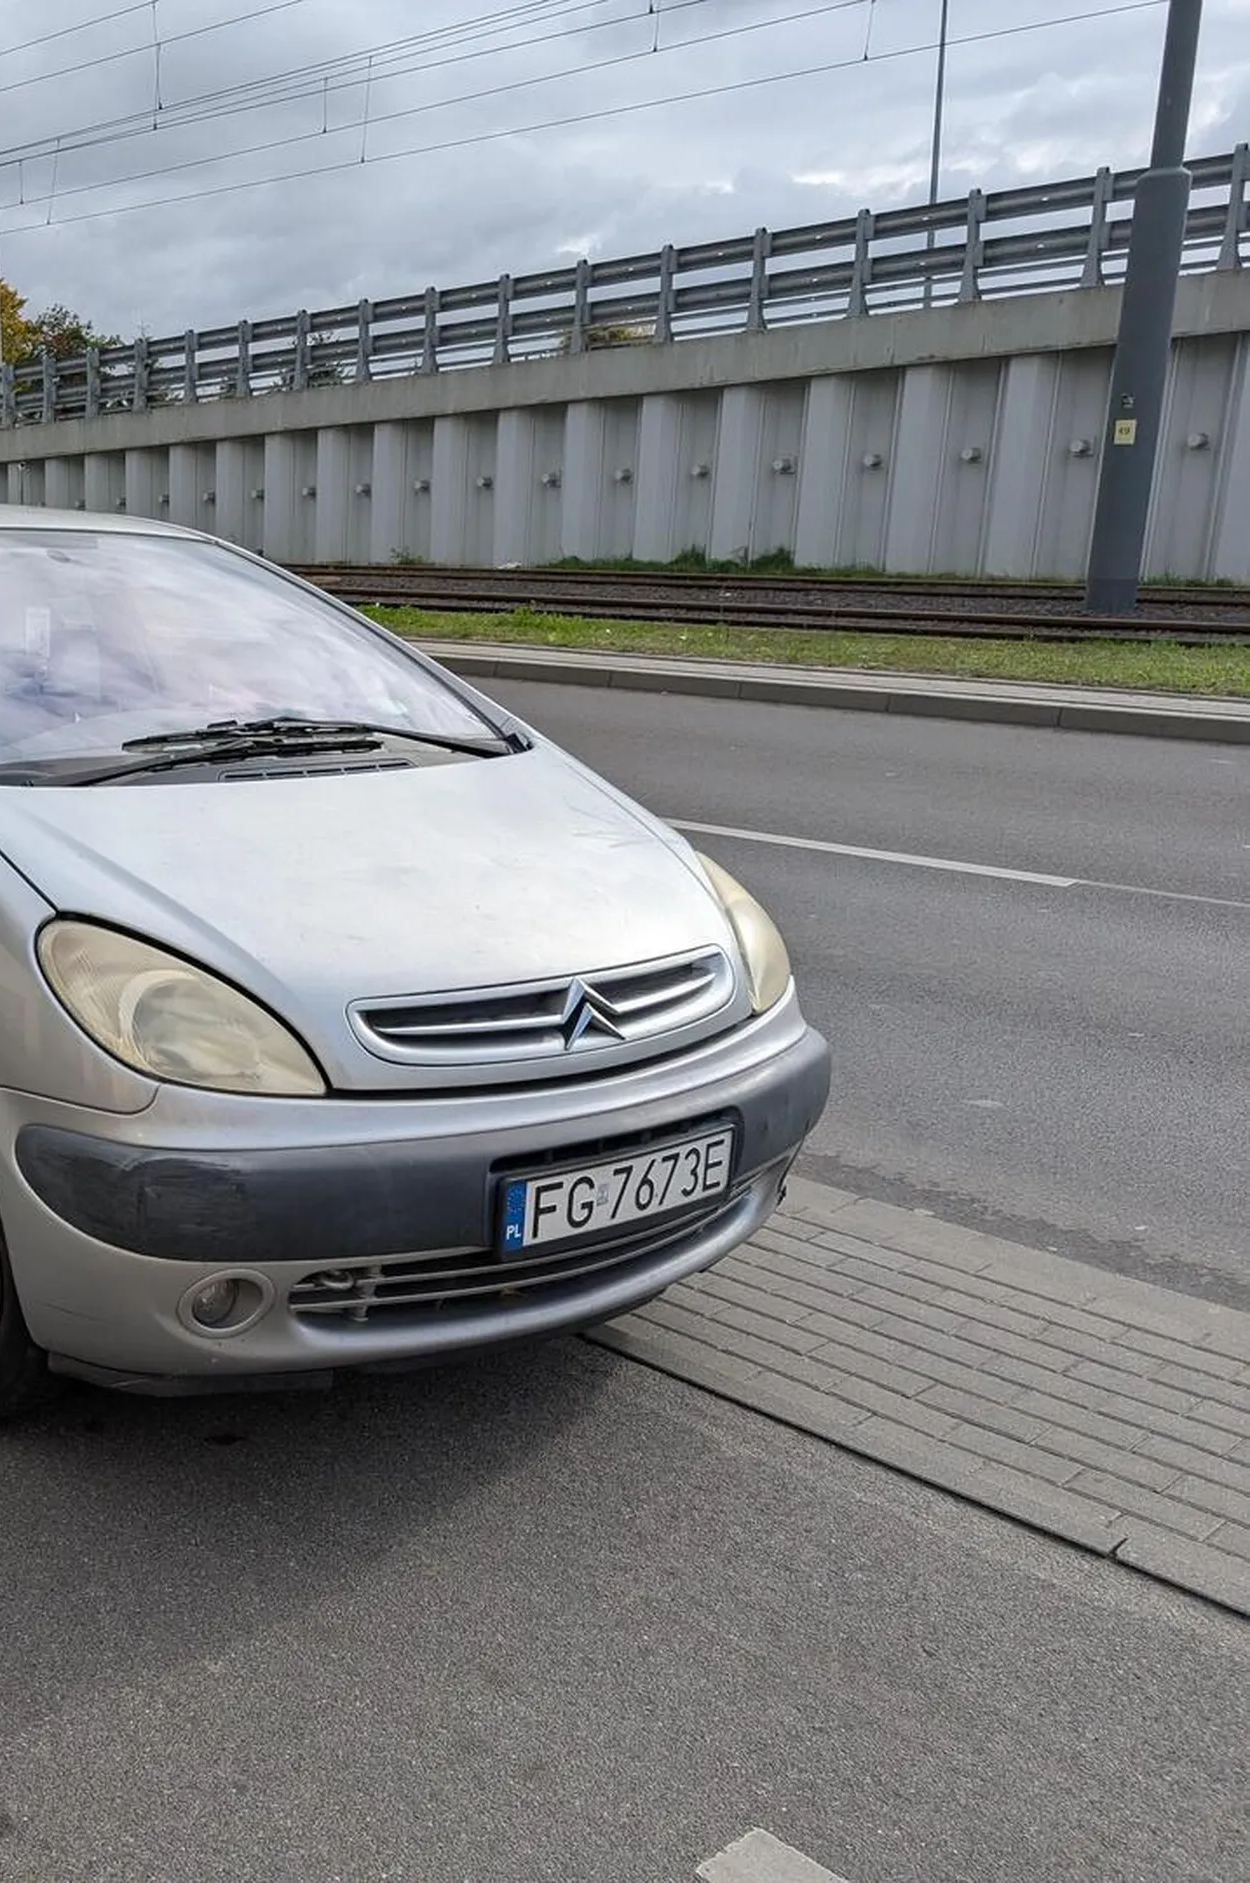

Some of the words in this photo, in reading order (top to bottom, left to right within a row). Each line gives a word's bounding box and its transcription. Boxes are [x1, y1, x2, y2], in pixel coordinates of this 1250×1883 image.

[532, 1176, 595, 1239] FG
[611, 1139, 725, 1219] 7673E
[506, 1224, 522, 1240] PL
